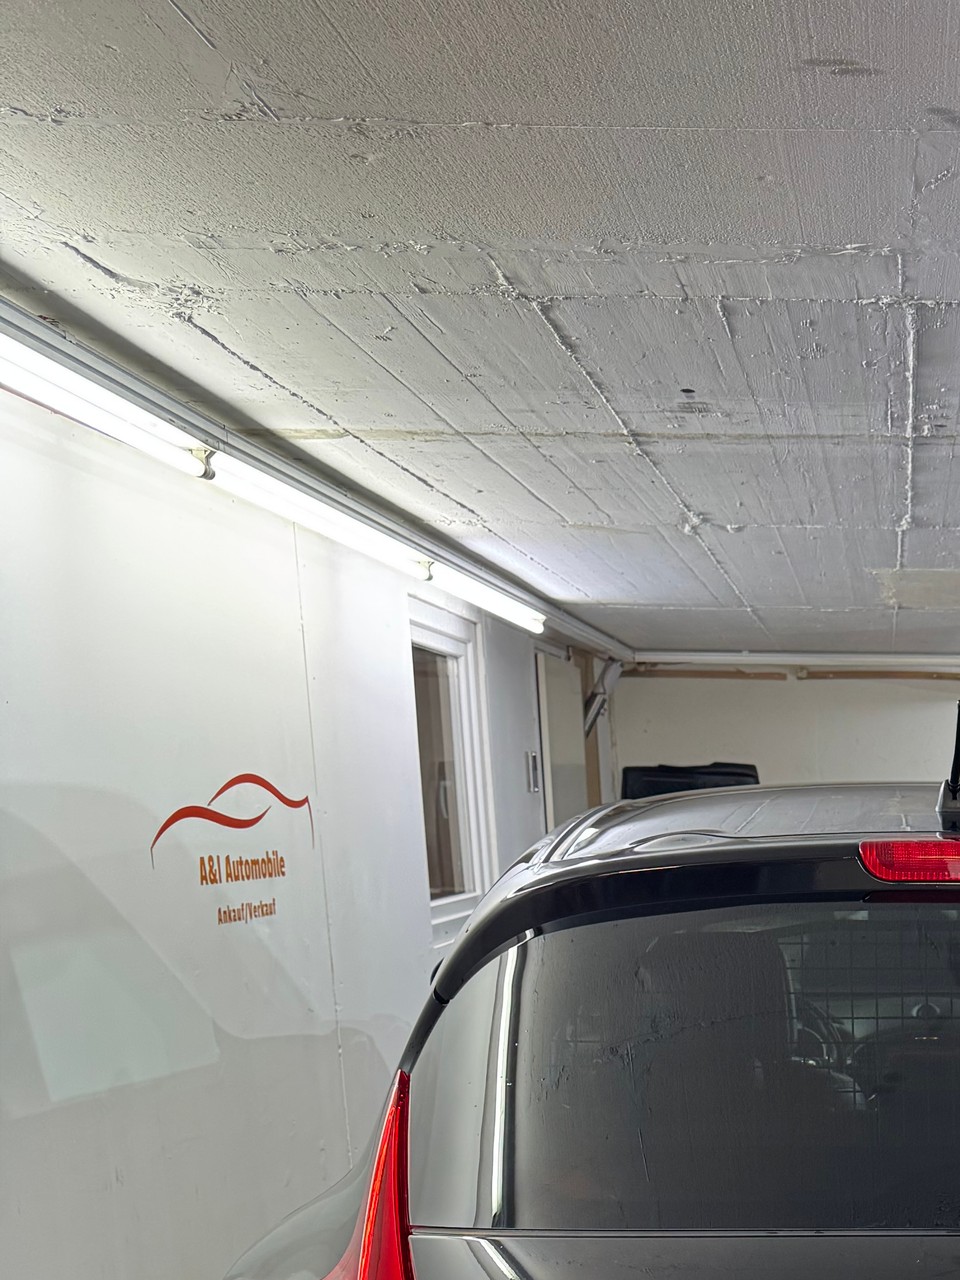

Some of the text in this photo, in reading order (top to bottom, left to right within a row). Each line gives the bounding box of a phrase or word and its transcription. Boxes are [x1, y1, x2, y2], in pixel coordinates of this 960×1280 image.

[200, 850, 287, 886] A&I Automobile
[217, 898, 276, 925] Ankauf/Verkauf
